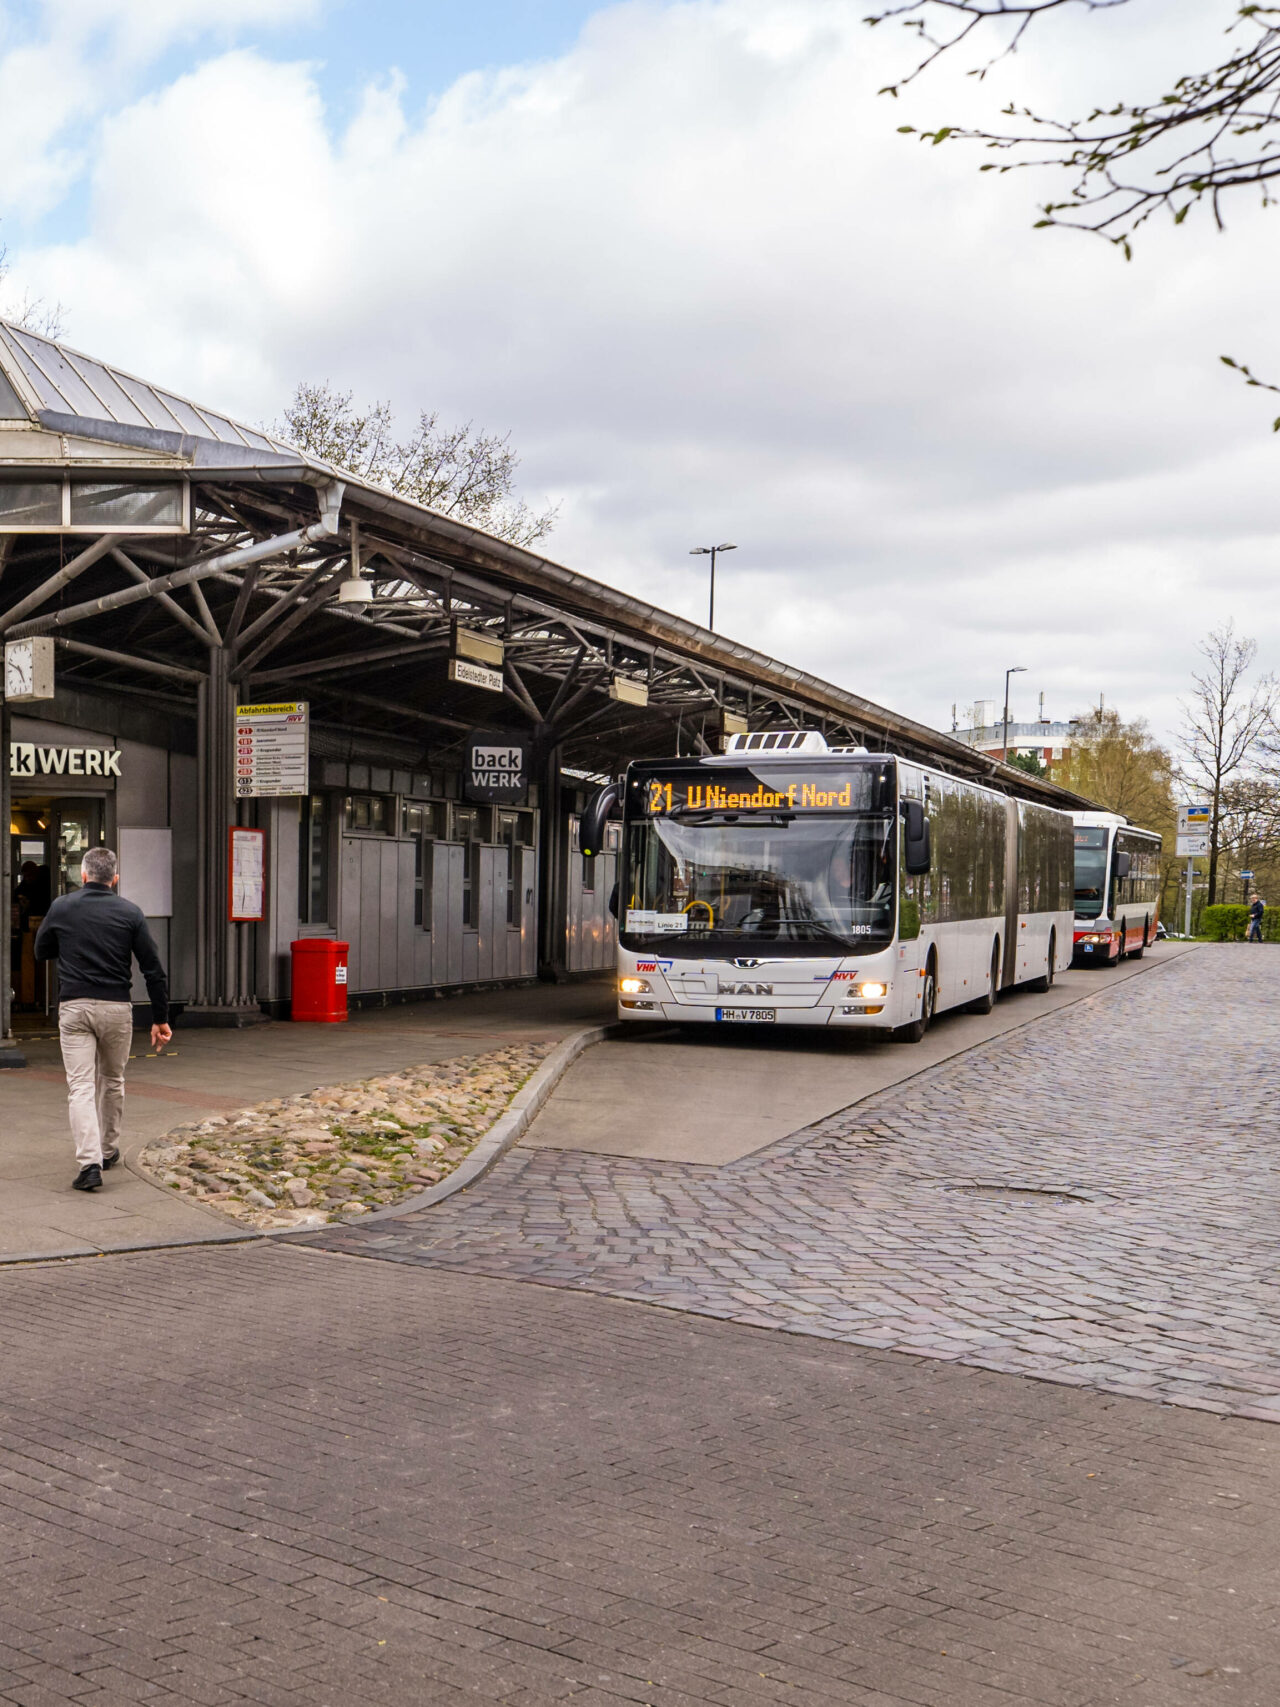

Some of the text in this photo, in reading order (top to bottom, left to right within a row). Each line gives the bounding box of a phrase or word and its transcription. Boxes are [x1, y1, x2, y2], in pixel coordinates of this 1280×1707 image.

[457, 664, 501, 688] Eidelstedter Platz
[239, 705, 294, 714] Abfahrtsbereich
[474, 749, 519, 768] back
[472, 772, 522, 788] WERK
[650, 783, 851, 811] 21 U Niendorf Nord
[852, 925, 871, 935] 1805
[637, 963, 657, 972] VHH
[834, 972, 858, 980] HVV
[719, 983, 773, 996] MAN
[722, 1010, 735, 1020] HH
[749, 1010, 774, 1020] 7805
